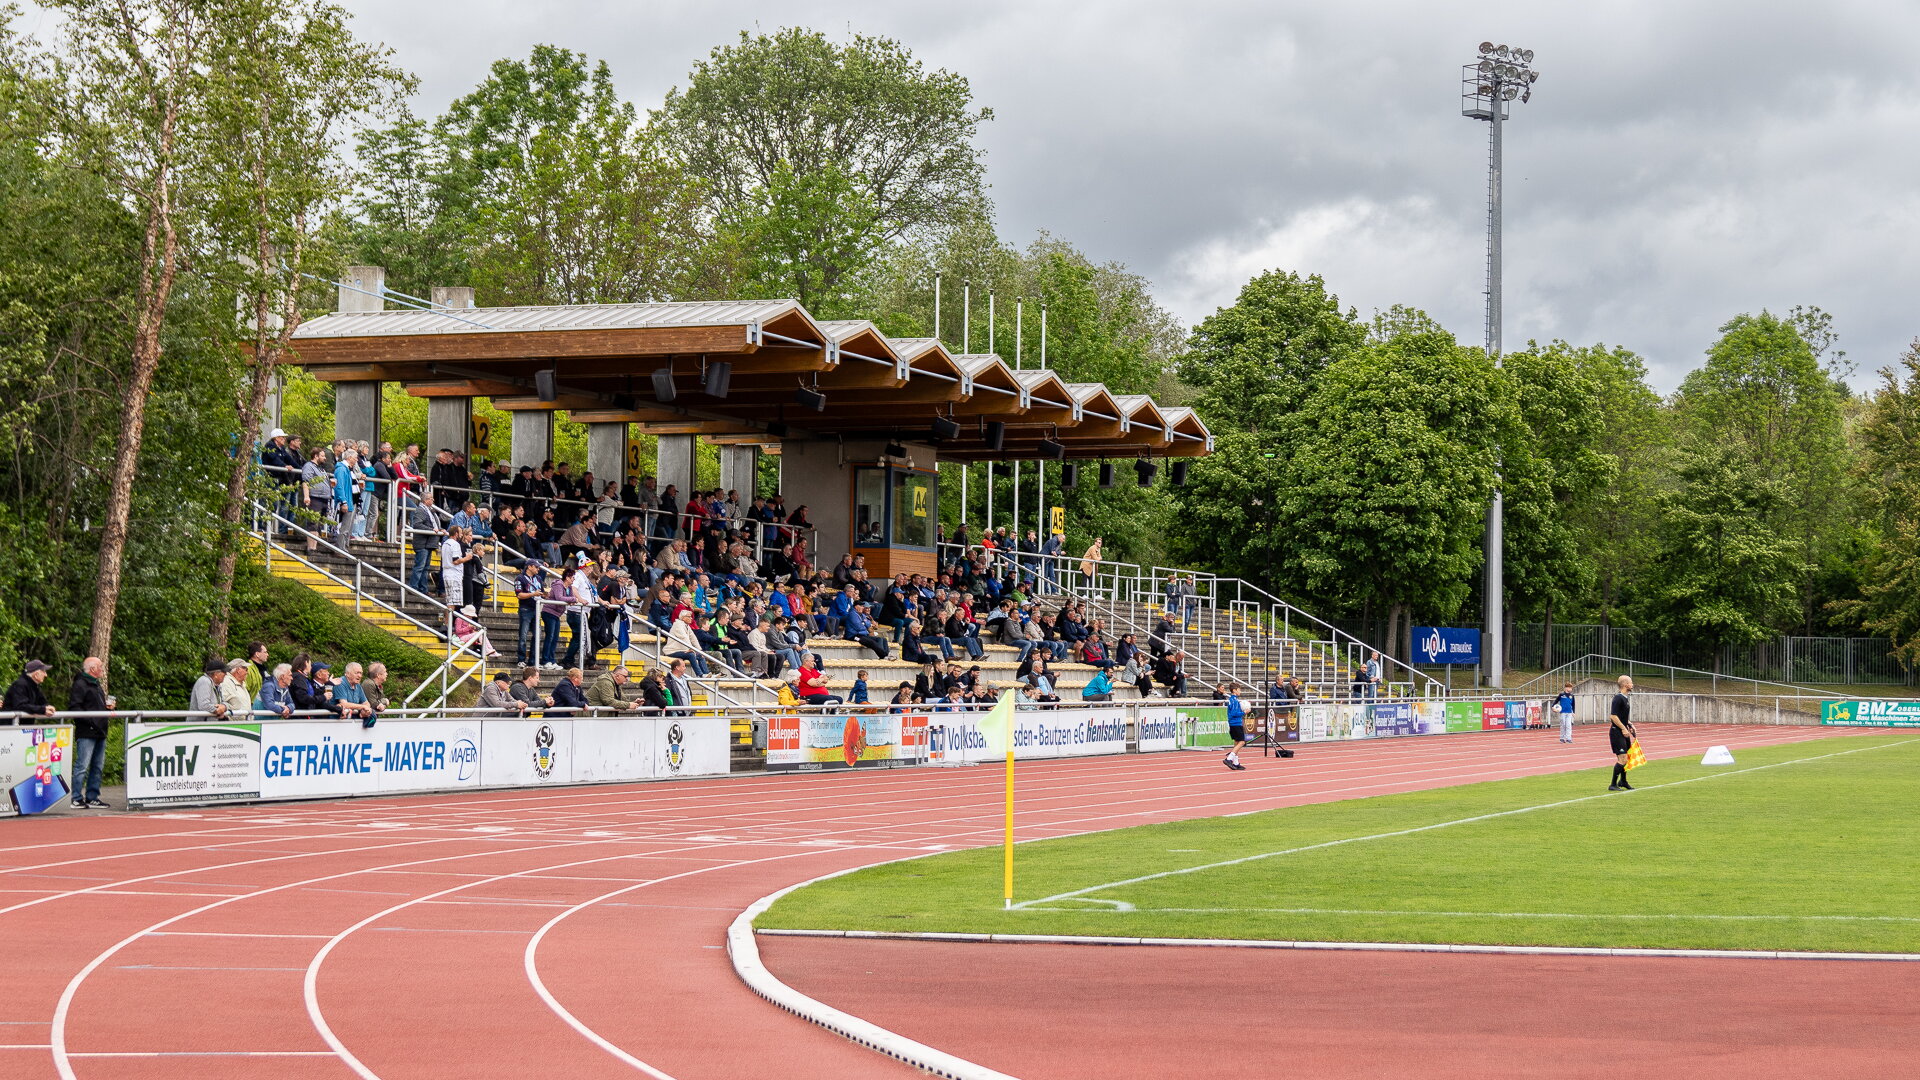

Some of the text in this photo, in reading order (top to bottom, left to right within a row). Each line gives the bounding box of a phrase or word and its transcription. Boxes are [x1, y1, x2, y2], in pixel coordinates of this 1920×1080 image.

[628, 444, 640, 470] 3
[914, 490, 928, 512] A4
[1053, 511, 1063, 530] A5
[1422, 634, 1446, 656] LAOLA
[1857, 702, 1899, 715] BMZ
[948, 724, 988, 751] Volksba
[1074, 722, 1084, 744] eG
[140, 745, 200, 778] RmTV
[156, 780, 208, 791] Dienstleistungen
